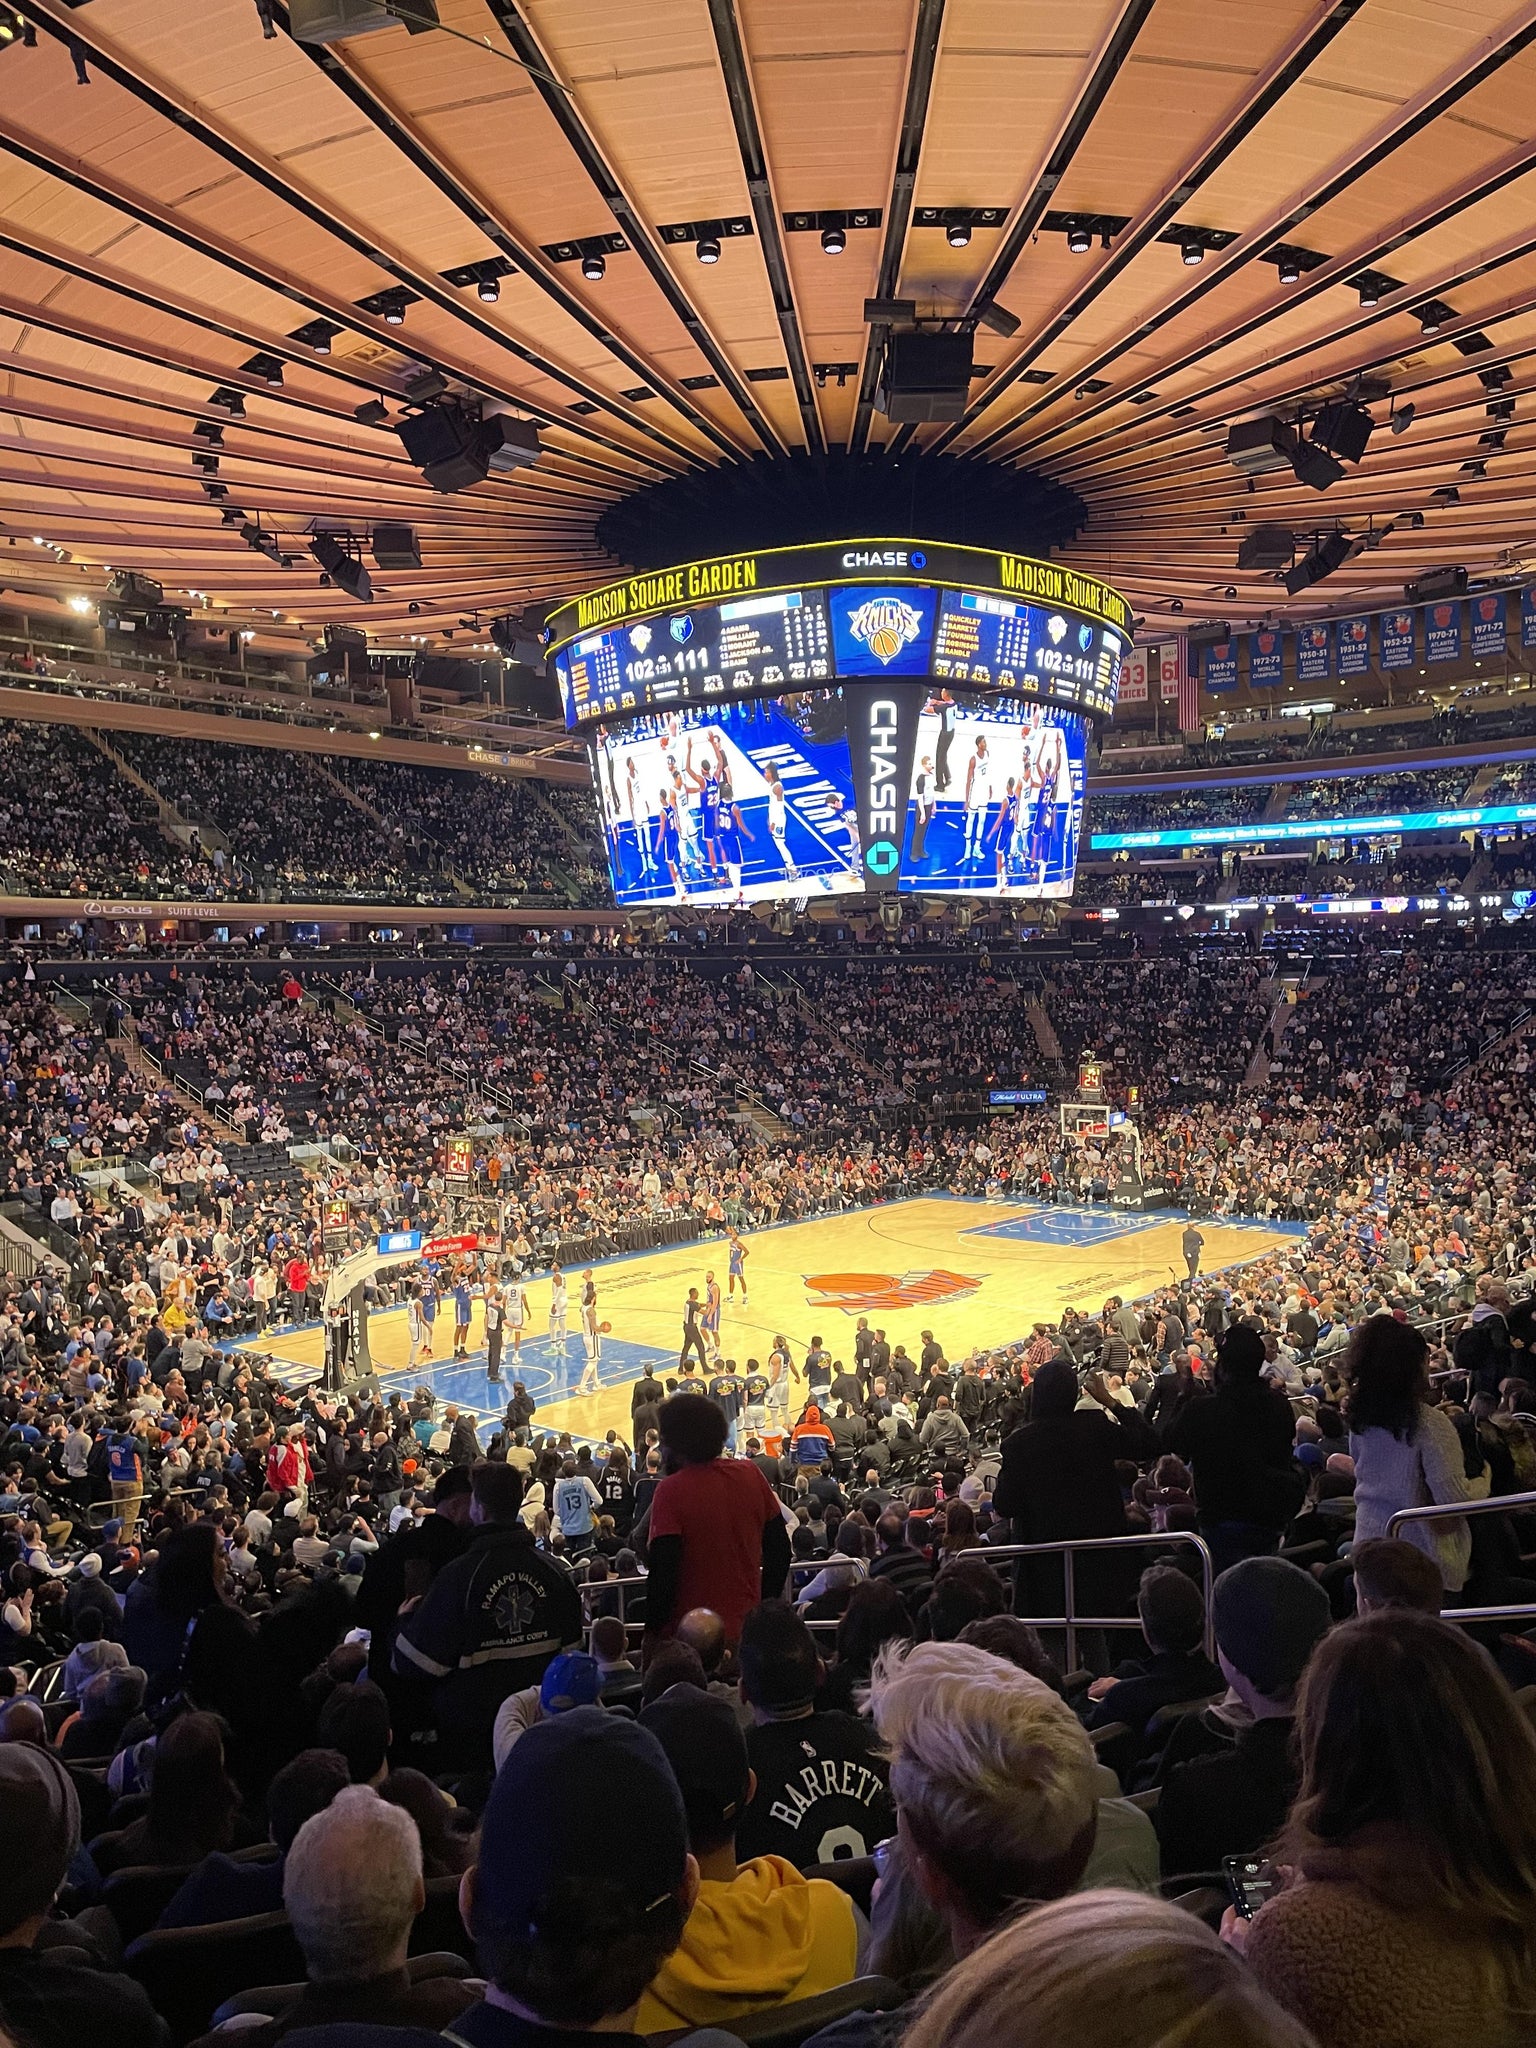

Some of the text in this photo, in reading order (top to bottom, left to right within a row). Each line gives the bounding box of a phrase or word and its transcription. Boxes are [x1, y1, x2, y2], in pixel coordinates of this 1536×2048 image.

[842, 552, 908, 567] CHASE
[578, 559, 757, 628] MADISON SQUARE GARDEN
[1001, 556, 1126, 626] MADISON SQUARE GARDEN
[850, 602, 920, 640] KNICKS
[949, 614, 981, 626] QUICKLEY
[948, 622, 977, 634] BARRETT
[1474, 622, 1504, 634] 1971-72
[947, 631, 979, 643] FOURNIER
[1428, 629, 1458, 640] 1970-71
[1476, 632, 1500, 641] EASTERN
[728, 640, 757, 650] MORANT
[945, 639, 979, 651] ROBINSON
[1383, 636, 1412, 647] 1952-53
[1431, 639, 1456, 648] ATLANTIC
[1471, 638, 1505, 649] CONFERENCE
[729, 647, 761, 658] JACKSON
[945, 647, 971, 658] RANDLE
[1299, 649, 1327, 659] 1950-51
[1340, 643, 1367, 654] 1951-52
[1386, 646, 1409, 655] EASTERN
[1432, 646, 1454, 654] DIVISION
[1474, 645, 1504, 655] CHAMPIONS
[1252, 655, 1281, 666] 1972-73
[1342, 653, 1365, 661] EASTERN
[1387, 653, 1408, 661] DIVISION
[1428, 651, 1458, 661] CHAMPIONS
[625, 658, 655, 682] 102
[655, 662, 672, 675] 1:51
[674, 647, 708, 672] 111
[1035, 648, 1062, 671] 102
[1075, 658, 1094, 680] 111
[1208, 661, 1236, 672] 1969-70
[1343, 659, 1364, 667] DIVISION
[1382, 658, 1412, 668] CHAMPIONS
[1257, 665, 1275, 673] WORLD
[1299, 670, 1328, 679] CHAMPIONS
[1303, 665, 1324, 673] DIVISION
[1339, 665, 1367, 674] CHAMPIONS
[733, 676, 754, 688] 66.7
[762, 671, 784, 683] 42.4
[791, 669, 805, 679] 42
[812, 666, 827, 677] 99
[936, 666, 949, 676] 35
[955, 668, 967, 679] 81
[971, 671, 990, 683] 43.2
[998, 675, 1016, 687] 76.9
[1022, 680, 1039, 692] 35.3
[1208, 676, 1236, 684] CHAMPIONS
[1252, 671, 1281, 679] CHAMPIONS
[1118, 688, 1146, 699] KNICKS
[469, 752, 500, 764] CHASE
[870, 700, 898, 835] CHASE
[1068, 759, 1083, 791] NEW
[1437, 812, 1471, 824] CHASE
[1122, 835, 1151, 845] CHASE
[1191, 830, 1235, 842] Celebrating
[1236, 829, 1257, 838] Black
[1257, 826, 1287, 838] history.
[1288, 823, 1332, 835] Supporting
[1347, 818, 1404, 830] communities.
[1417, 895, 1502, 911] 102 1:51 111
[102, 906, 219, 917] LEXUS SUITE LEVEL
[1084, 1075, 1099, 1087] 24
[450, 1153, 467, 1171] 24
[981, 1199, 1042, 1210] NEW
[328, 1213, 343, 1225] 24
[510, 1288, 517, 1298] 8
[352, 1309, 361, 1355] NBA TV
[605, 1485, 622, 1500] 12
[565, 1495, 582, 1510] 13
[481, 1572, 547, 1610] RAMAPO VALLEY
[481, 1630, 548, 1647] AMBULANCE CORPS
[770, 1760, 884, 1829] BARRETT
